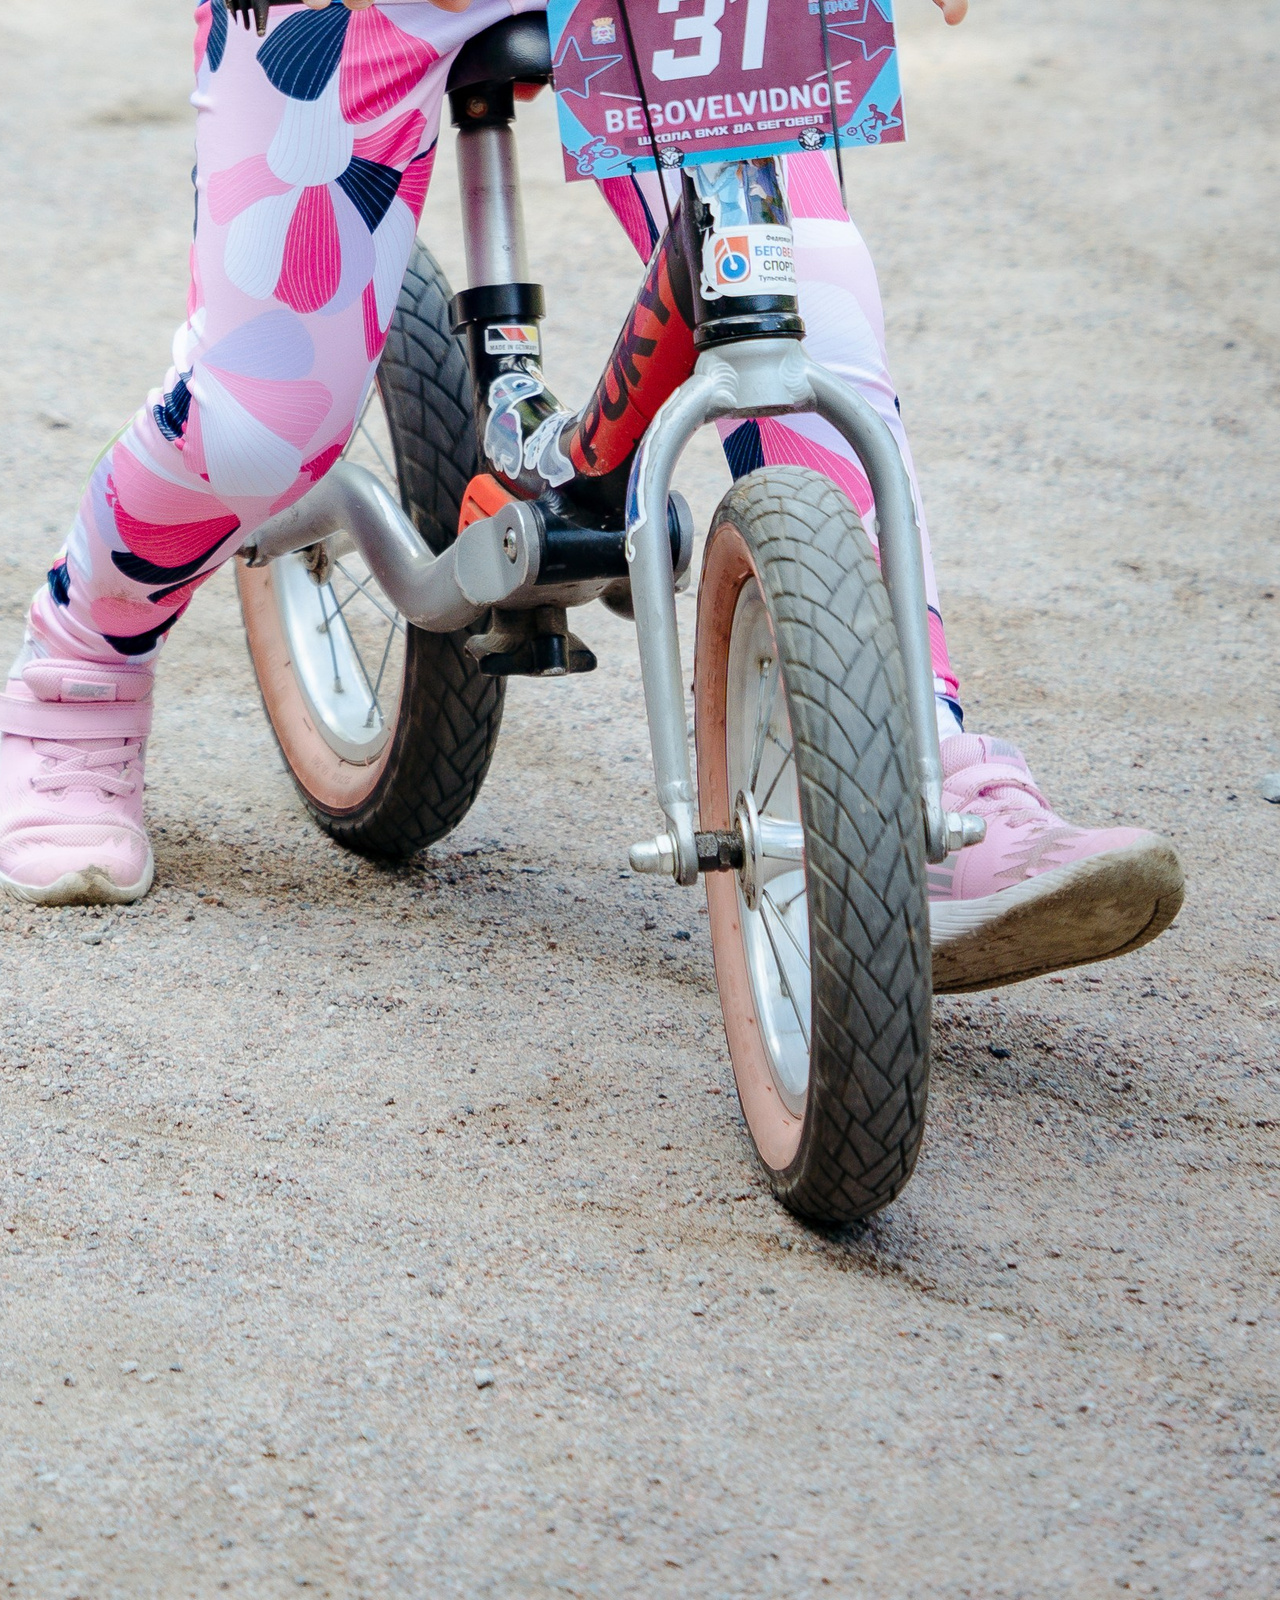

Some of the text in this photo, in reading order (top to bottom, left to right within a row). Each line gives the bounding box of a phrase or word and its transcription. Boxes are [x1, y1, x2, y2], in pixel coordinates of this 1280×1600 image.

[604, 80, 854, 134] BEGOVELVIDNOE
[637, 131, 692, 147] ШКОЛА
[733, 123, 755, 135] ДА
[757, 114, 824, 132] БЕГОВЕЛ
[754, 245, 794, 259] БЕГОВЕ
[763, 259, 796, 273] СПОРТ
